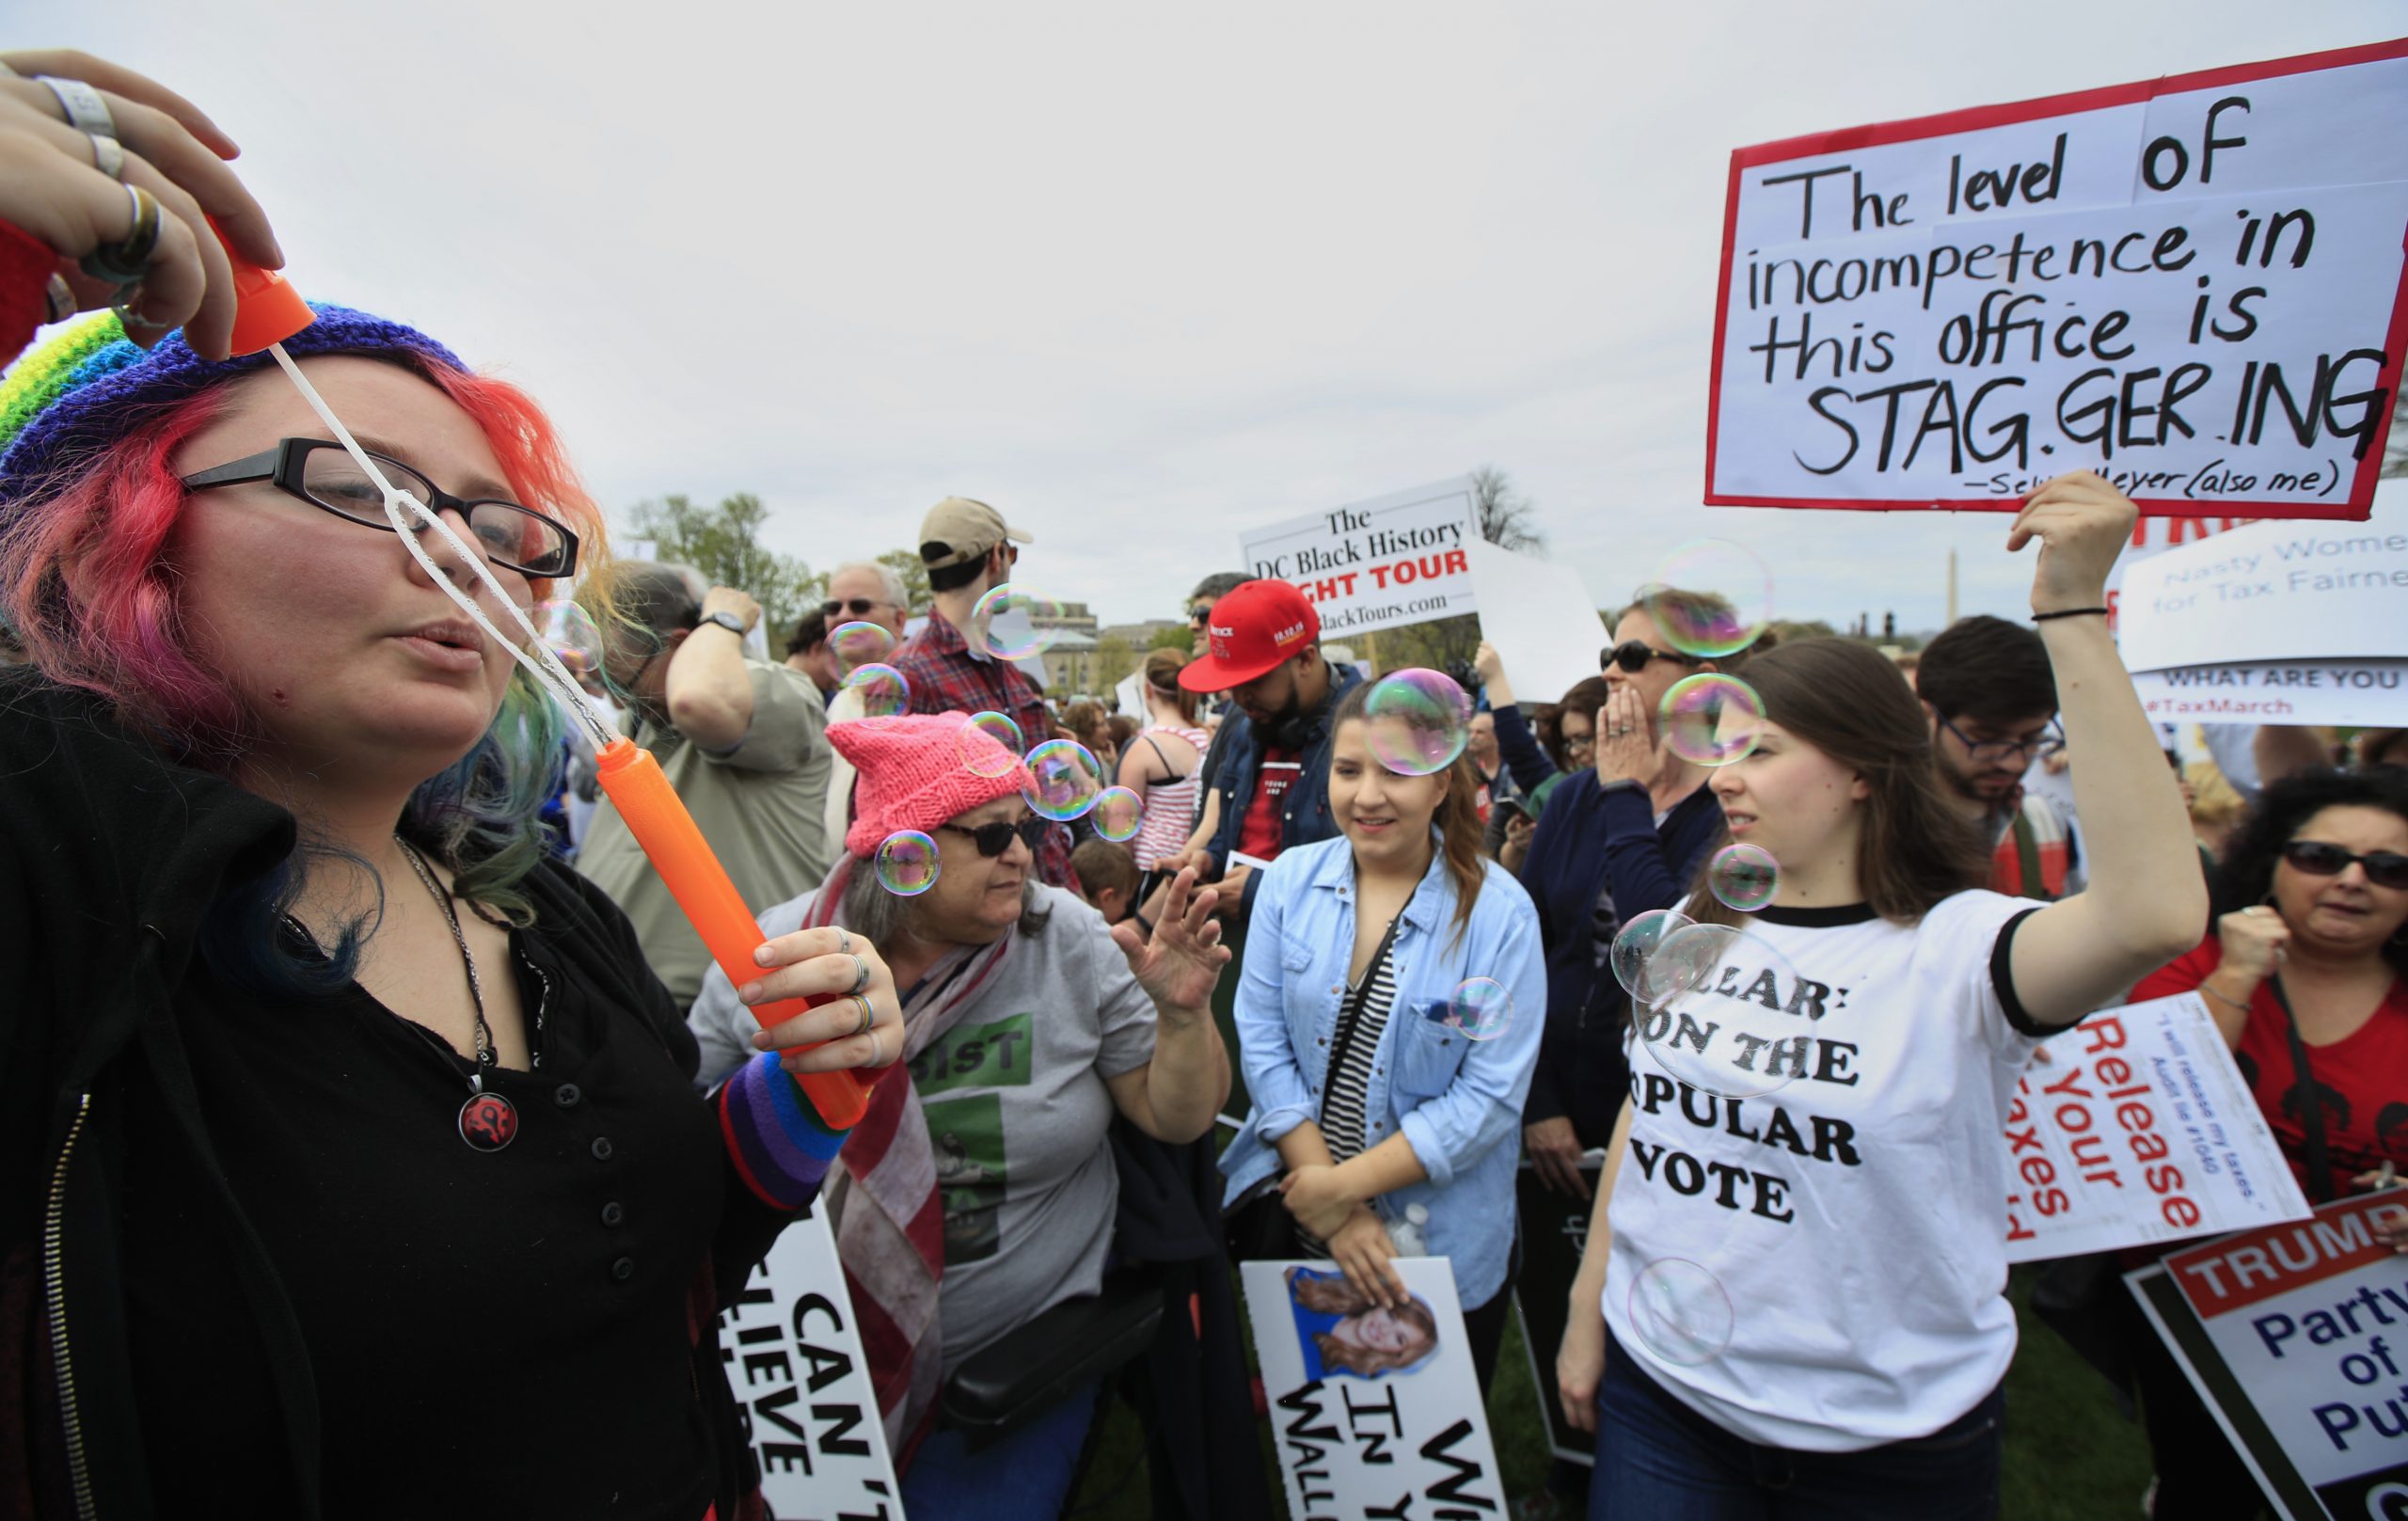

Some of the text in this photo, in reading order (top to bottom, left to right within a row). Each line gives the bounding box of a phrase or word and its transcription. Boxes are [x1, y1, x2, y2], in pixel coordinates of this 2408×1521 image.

[1762, 166, 1914, 239] The
[1946, 133, 2067, 214] level
[1748, 207, 2315, 310] incompetence in
[1750, 276, 2267, 384] this office is
[2183, 458, 2258, 499] (also
[2268, 458, 2339, 497] me)
[1255, 520, 1465, 580] DC Black History
[1325, 508, 1372, 535] The
[2163, 533, 2408, 588] Nasty Wome
[1298, 549, 1468, 603] GHT TOUR
[1318, 594, 1449, 632] lackTours.com
[2153, 567, 2408, 614] for Tax Fairne
[2145, 698, 2294, 714] #TaxMarch
[2163, 668, 2400, 689] WHAT ARE YOU
[907, 1030, 1023, 1084] SIST
[1642, 1006, 1860, 1087] ON THE
[1630, 1070, 1862, 1166] PULAR
[2042, 1067, 2124, 1190] Your
[2075, 1016, 2202, 1228] Release
[2178, 1058, 2216, 1120] release
[2208, 1121, 2230, 1149] my
[1629, 1136, 1795, 1224] VOTE
[2004, 1076, 2072, 1219] axes
[731, 1259, 814, 1478] LIEVE
[2338, 1334, 2402, 1386] of
[1275, 1379, 1345, 1521] WALL
[1340, 1382, 1404, 1465] IN
[2311, 1383, 2408, 1452] Pu
